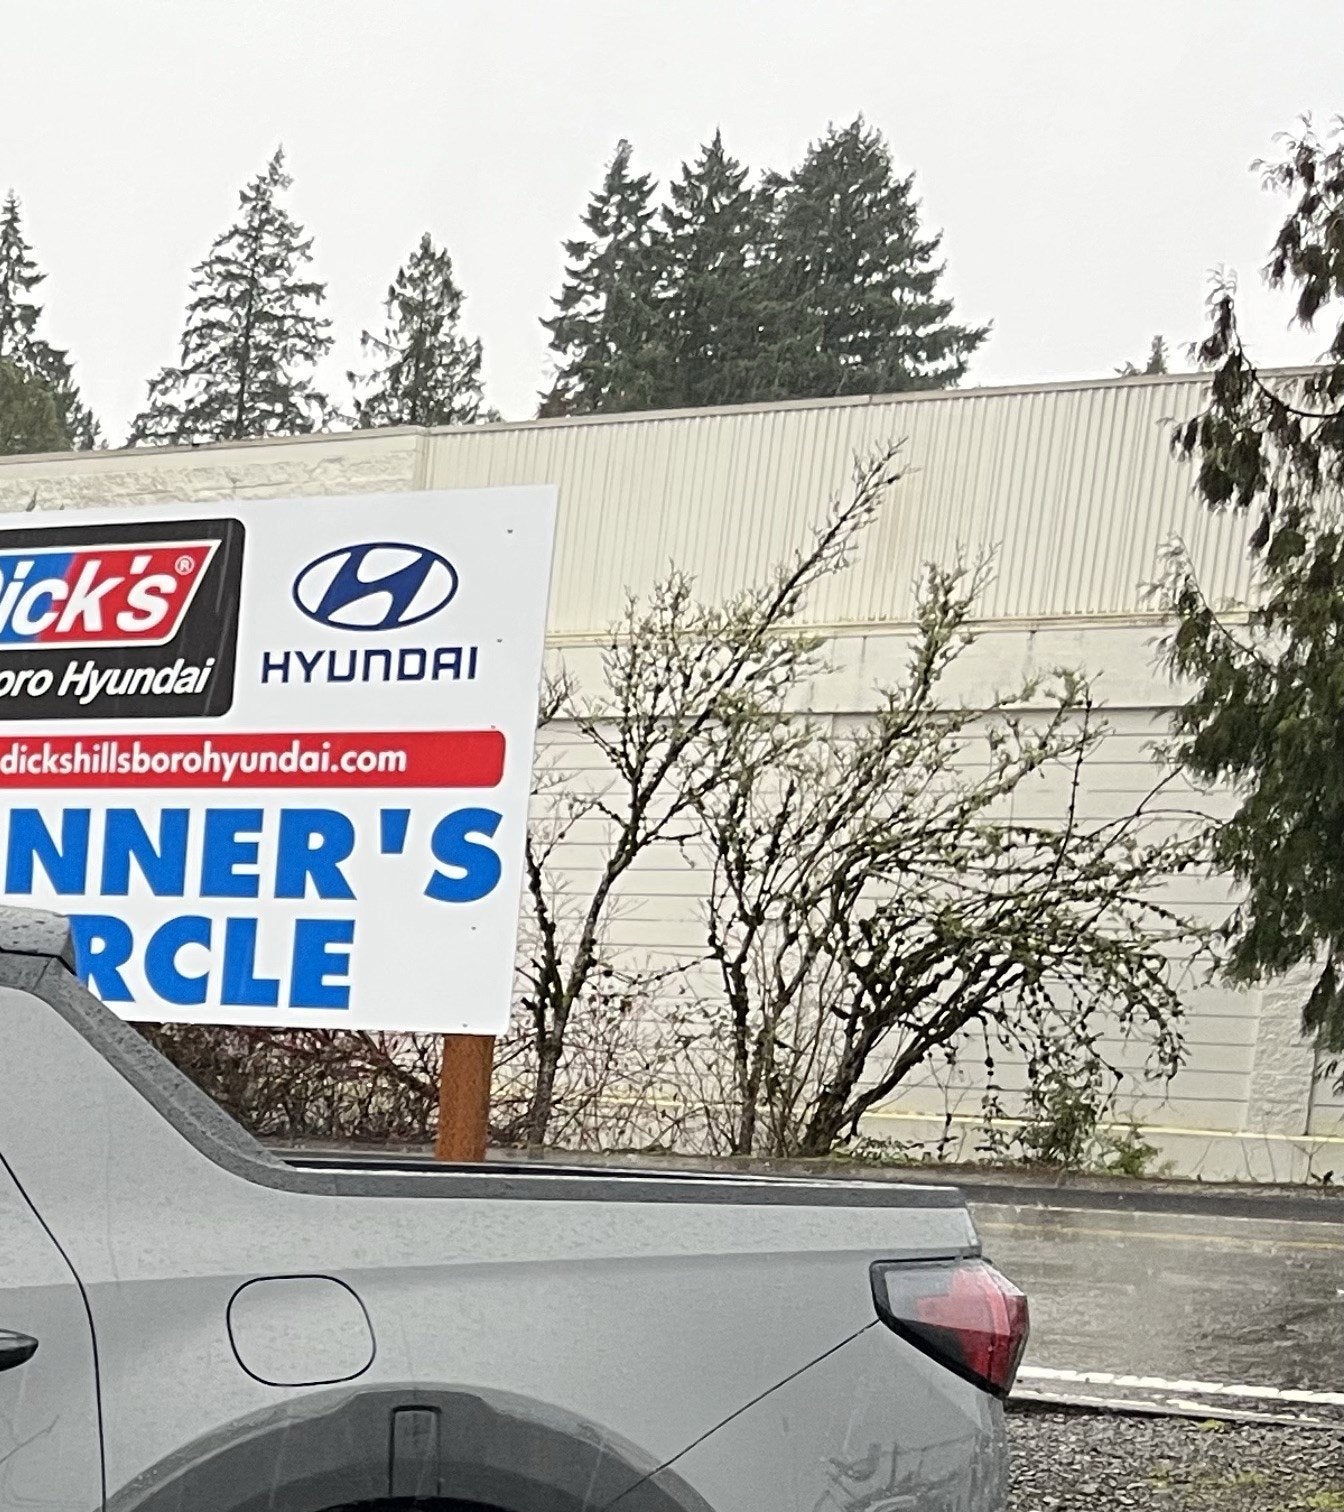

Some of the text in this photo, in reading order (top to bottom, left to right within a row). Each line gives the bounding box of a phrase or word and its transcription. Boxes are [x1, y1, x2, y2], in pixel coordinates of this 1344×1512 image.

[57, 657, 216, 705] Hyundai
[261, 646, 478, 684] HYUNDAI
[69, 914, 355, 1010] RCLE
